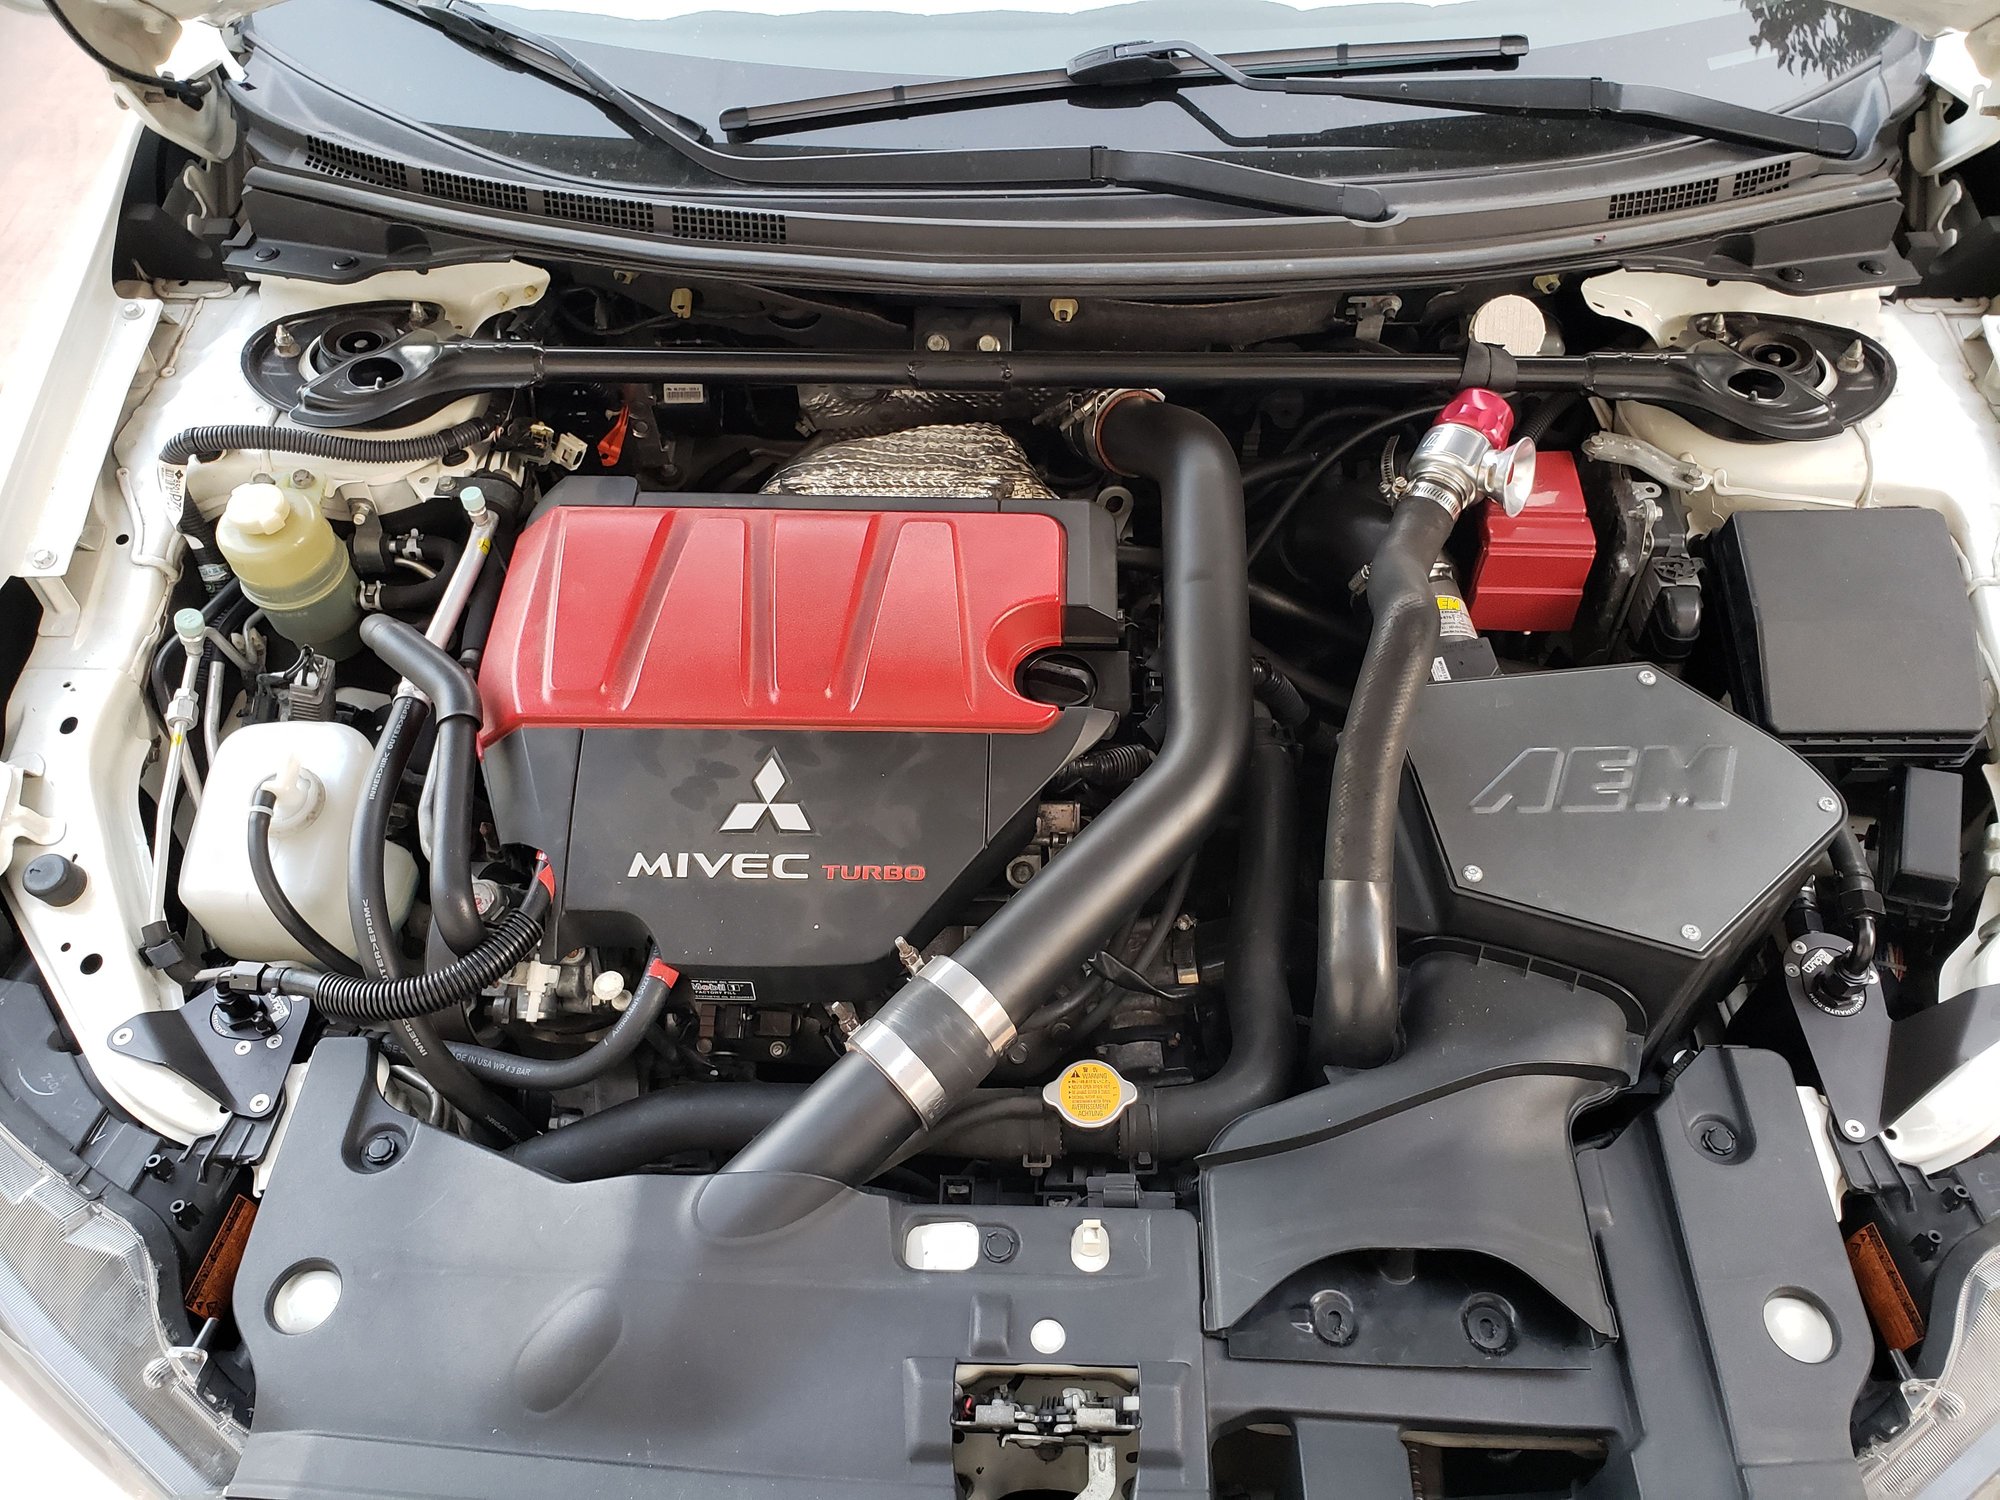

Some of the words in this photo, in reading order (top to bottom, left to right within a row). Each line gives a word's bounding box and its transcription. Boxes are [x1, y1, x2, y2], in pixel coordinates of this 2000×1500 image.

[1437, 597, 1461, 611] EM
[1468, 744, 1738, 814] AEM
[627, 851, 810, 879] MIVEC
[821, 863, 926, 881] TURBO
[477, 1057, 493, 1069] USA
